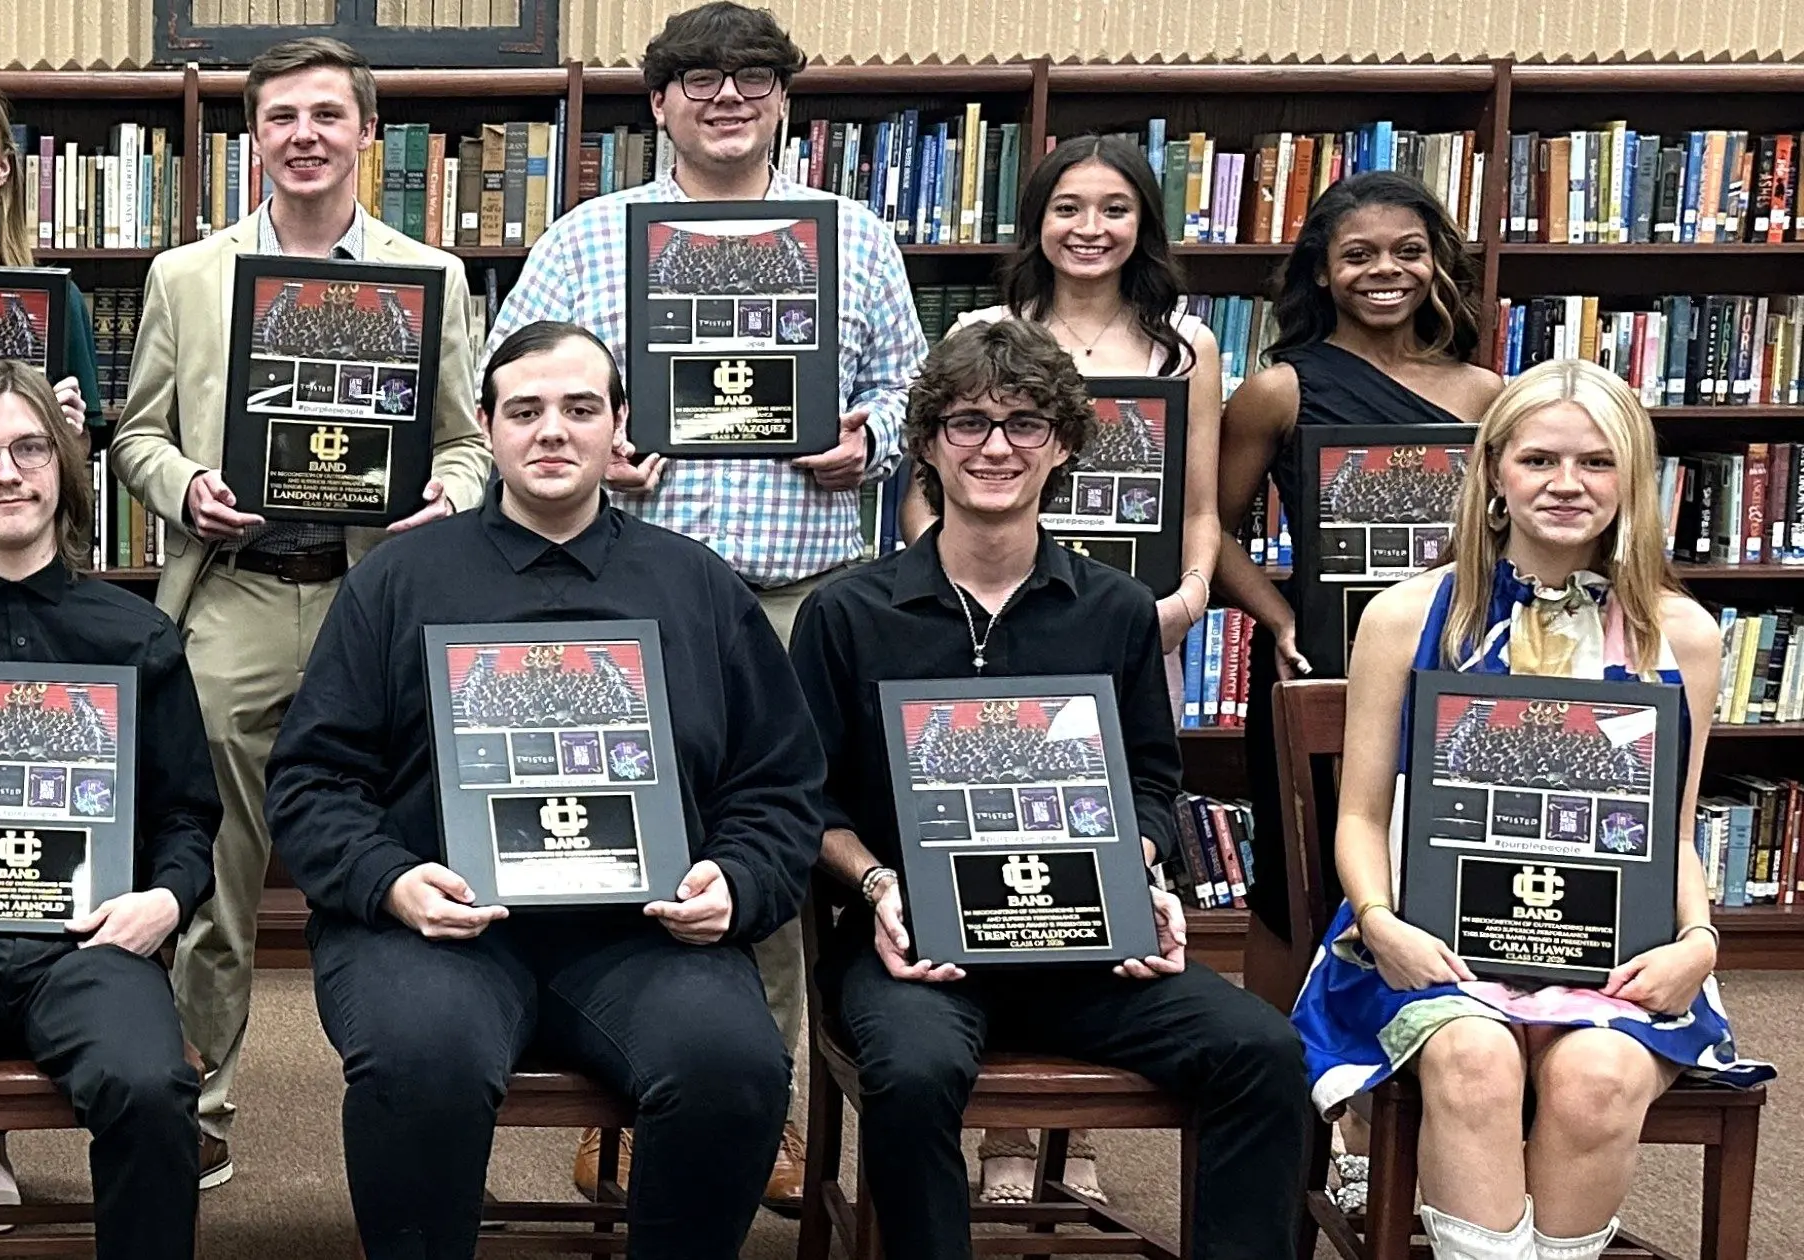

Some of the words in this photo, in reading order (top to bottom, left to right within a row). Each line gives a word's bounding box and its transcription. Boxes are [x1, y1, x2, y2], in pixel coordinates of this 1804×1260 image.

[714, 395, 752, 404] BAND
[309, 460, 346, 472] BAND
[273, 488, 320, 500] LANDON
[322, 491, 378, 503] MCADAMS
[543, 837, 590, 849] BAND
[1007, 894, 1053, 906] BAND
[1512, 906, 1562, 921] BAND
[973, 928, 1019, 940] TRENT
[1019, 926, 1097, 939] CRADDOCK
[1488, 939, 1529, 953] CARA
[1532, 942, 1583, 957] HAWKS
